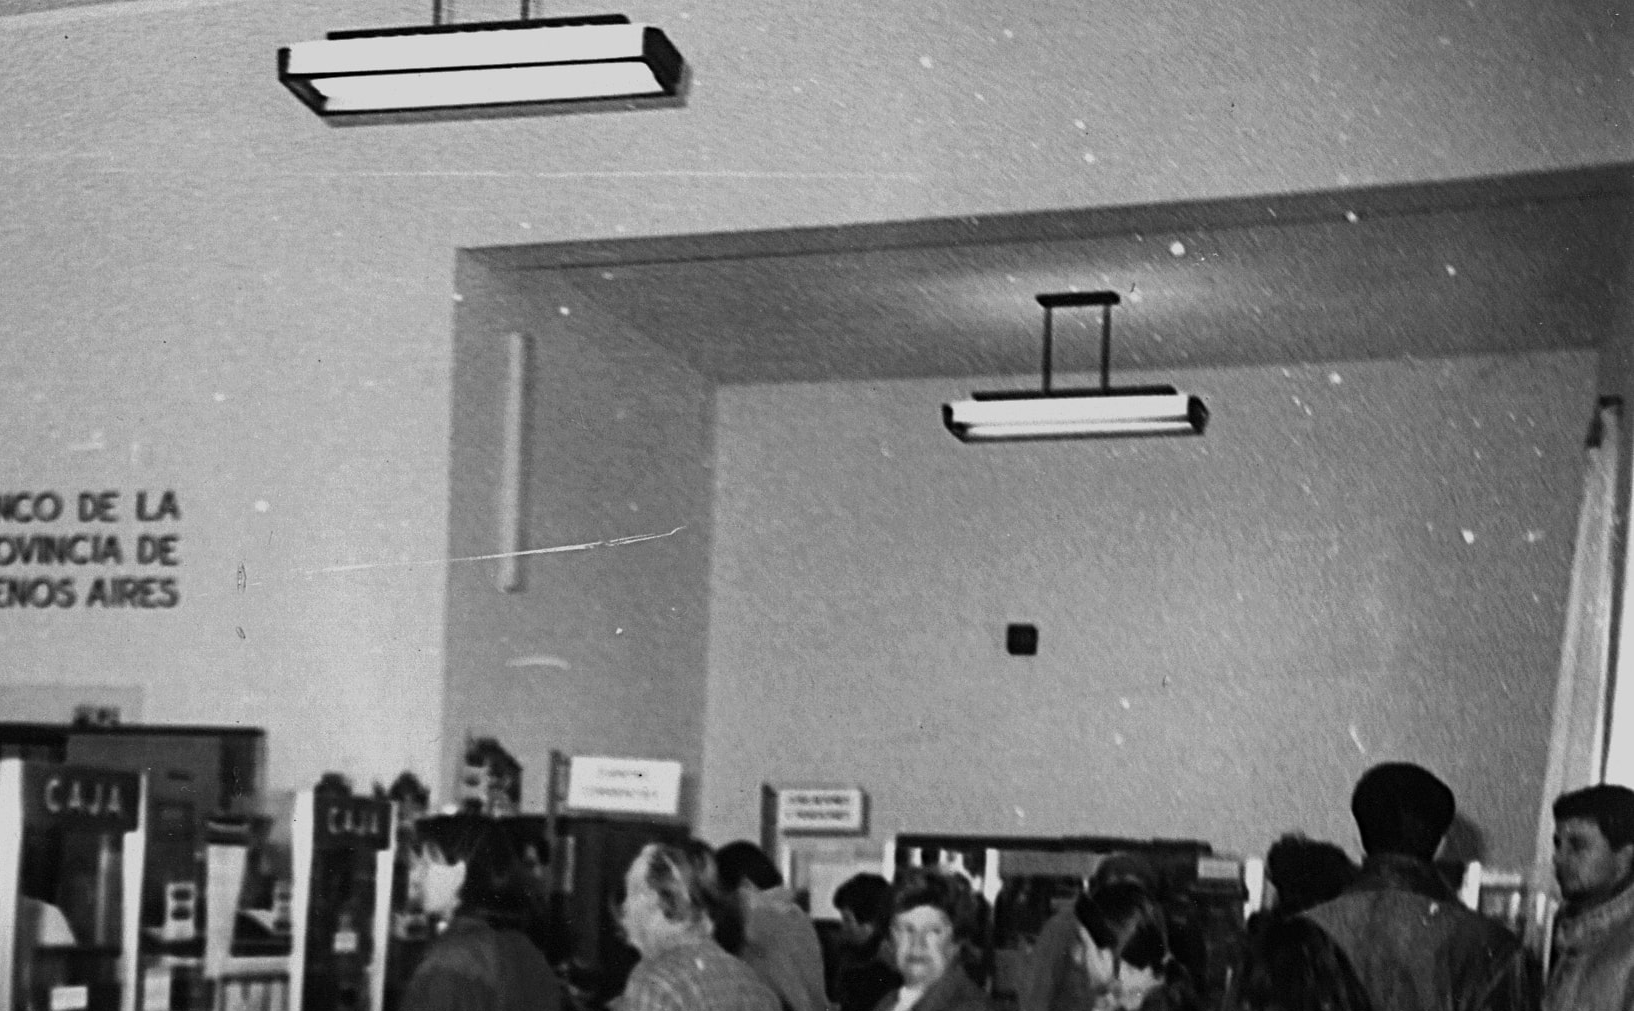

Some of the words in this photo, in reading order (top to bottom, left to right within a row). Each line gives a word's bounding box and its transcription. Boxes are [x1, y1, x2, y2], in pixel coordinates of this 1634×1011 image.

[77, 491, 119, 523] DE
[135, 490, 181, 523] LA
[136, 533, 180, 566] DE
[84, 577, 180, 609] AIRES
[45, 778, 122, 816] CAJA
[327, 805, 379, 836] CAJA
